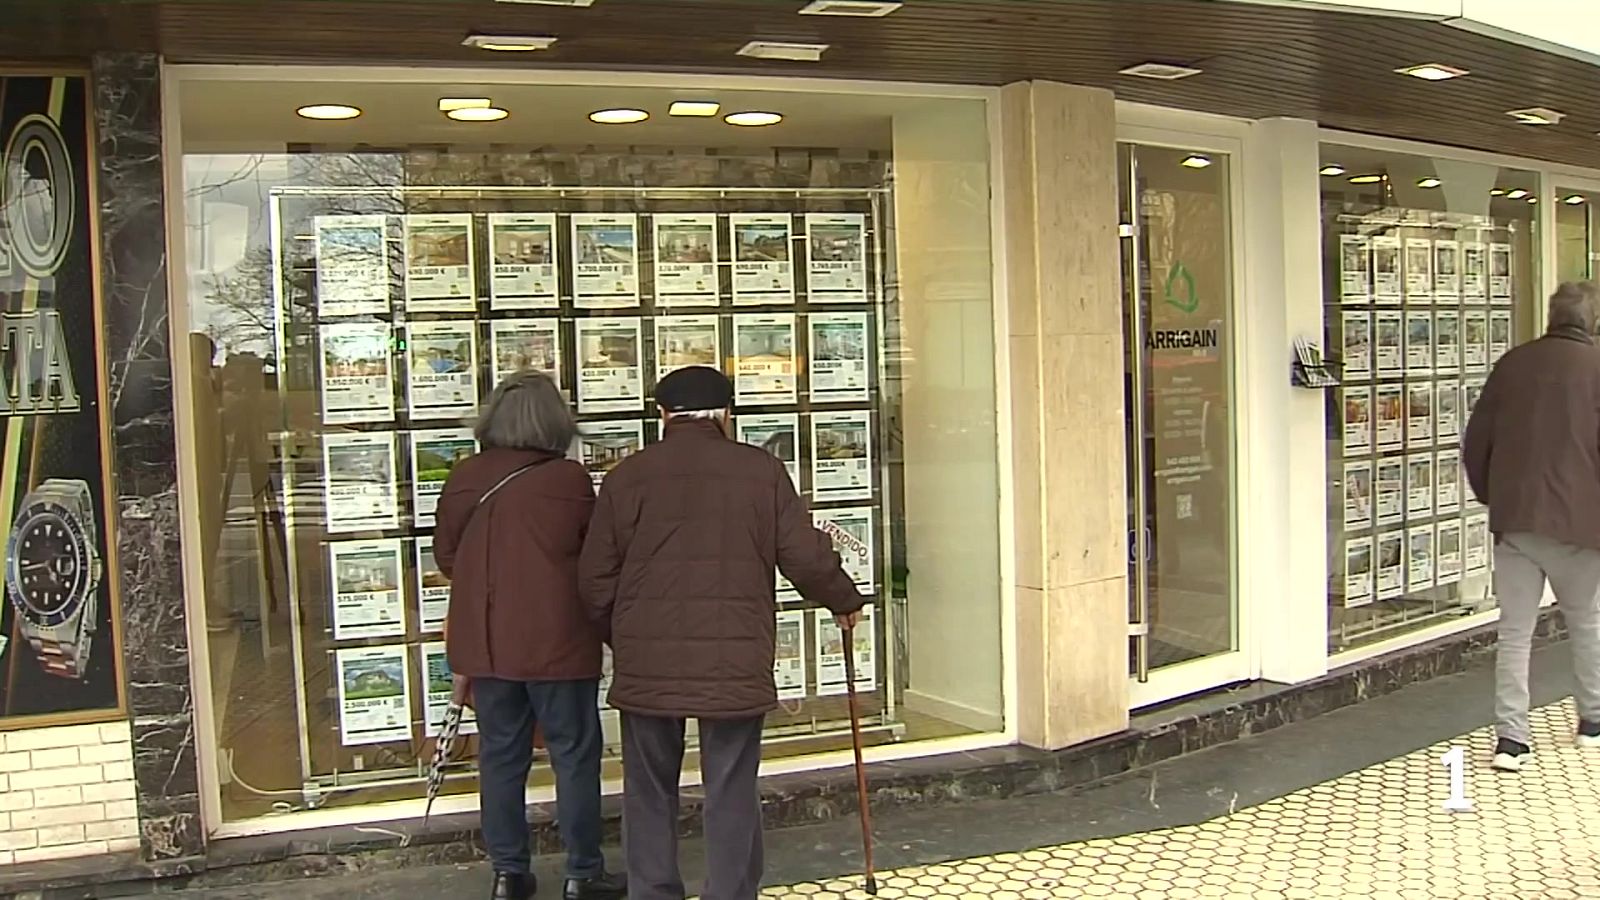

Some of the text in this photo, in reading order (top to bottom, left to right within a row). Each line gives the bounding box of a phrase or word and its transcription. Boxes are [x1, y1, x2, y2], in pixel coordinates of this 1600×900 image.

[0, 113, 75, 277] O
[1144, 329, 1217, 350] ARRIGAIN
[822, 519, 868, 558] VENDIDO
